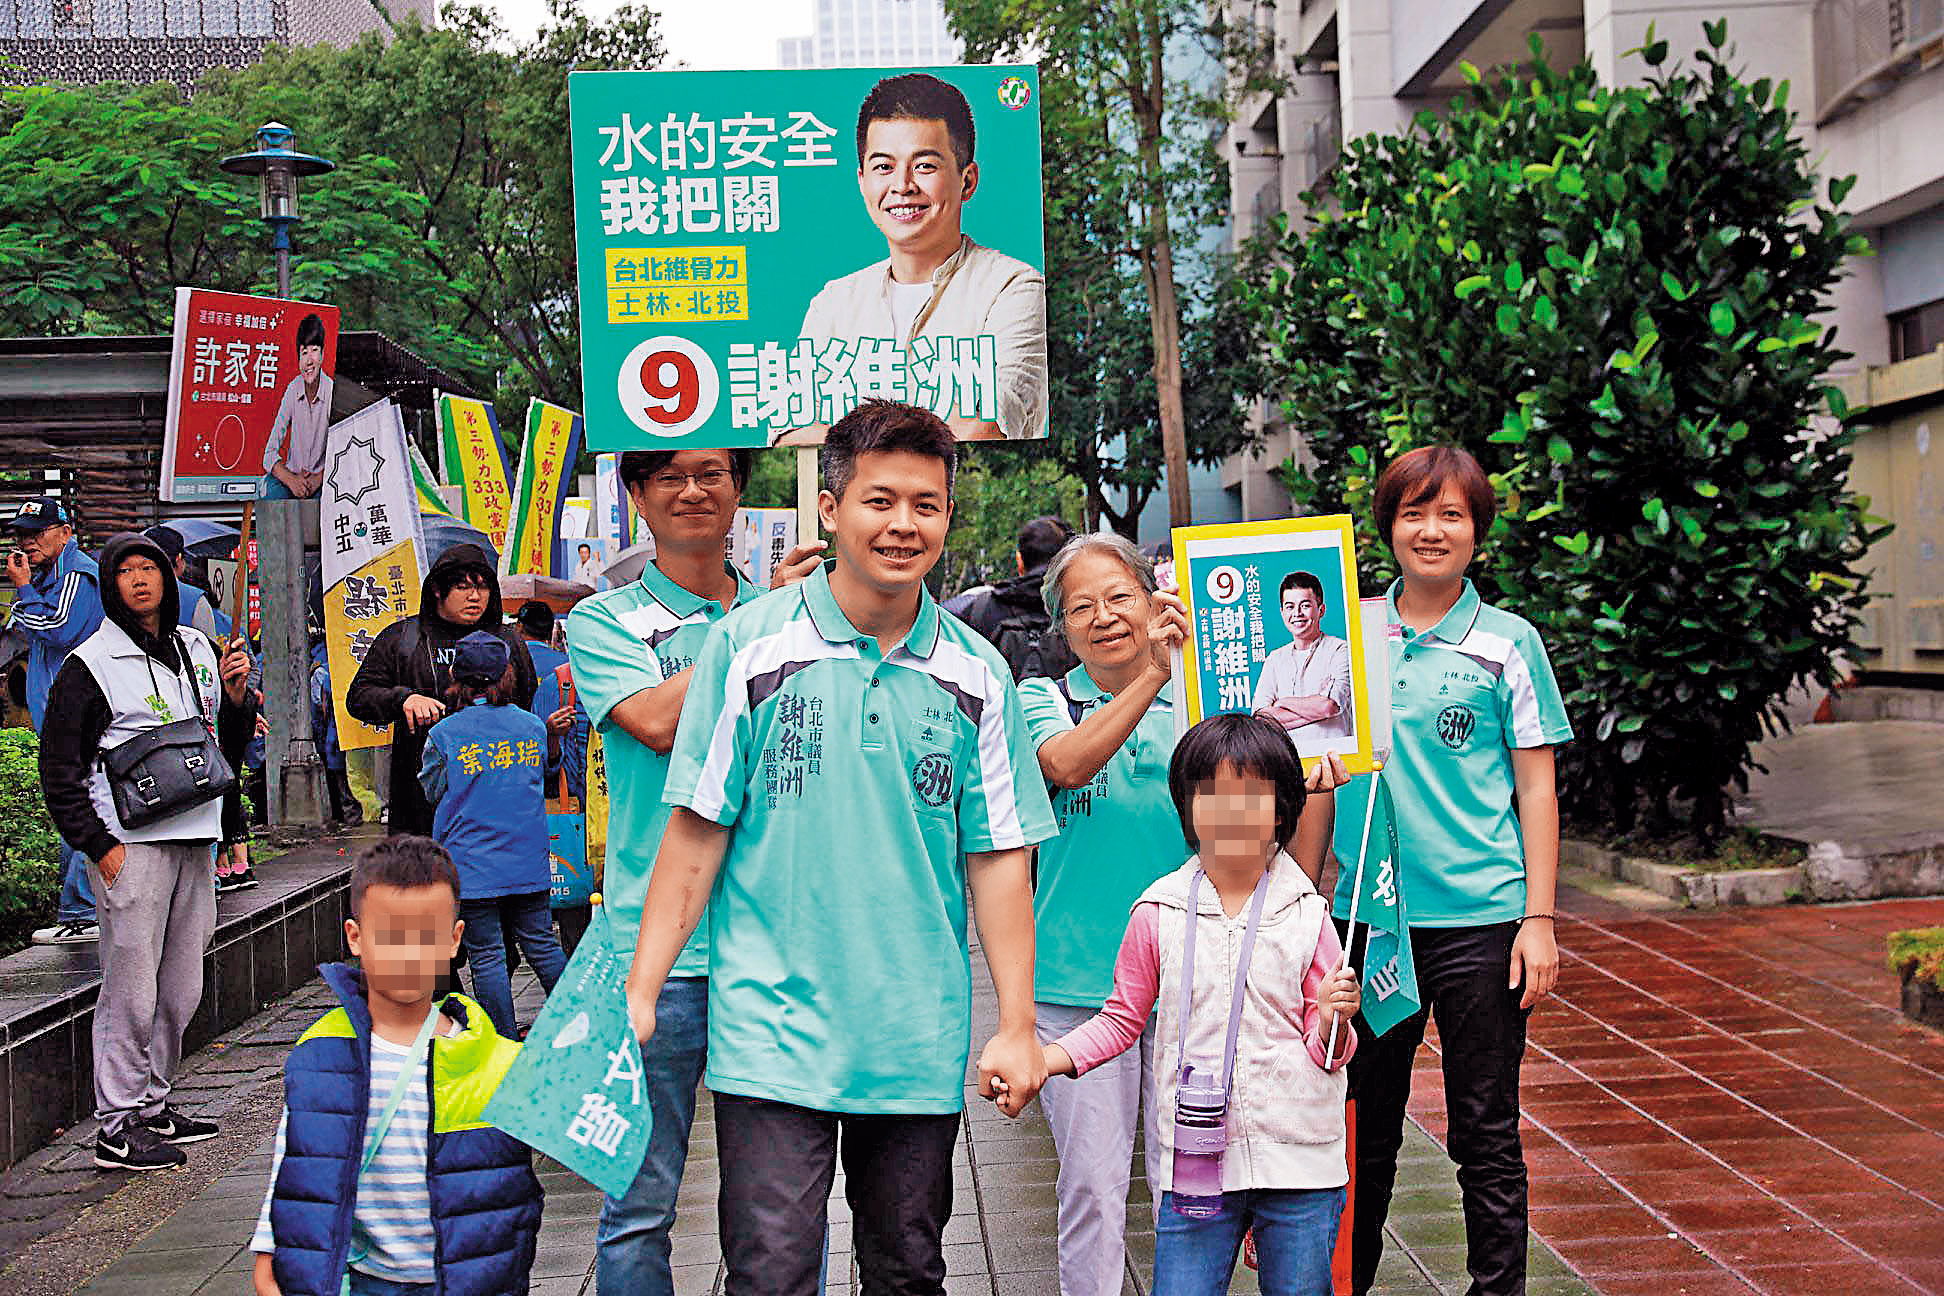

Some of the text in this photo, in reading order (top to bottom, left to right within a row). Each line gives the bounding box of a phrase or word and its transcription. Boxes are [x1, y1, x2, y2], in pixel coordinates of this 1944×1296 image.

[598, 111, 838, 172] 水的安全
[600, 175, 780, 236] 我把關
[613, 255, 738, 282] 台北維骨力
[193, 336, 280, 389] 許家蓓
[640, 335, 998, 429] 9 謝維洲
[1216, 572, 1234, 599] 9
[1245, 564, 1266, 663] 水的安全我把關
[1211, 605, 1252, 711] 謝維洲
[779, 693, 807, 800] 謝維洲
[808, 696, 823, 776] 台北市議員
[763, 748, 777, 810] 服務團隊
